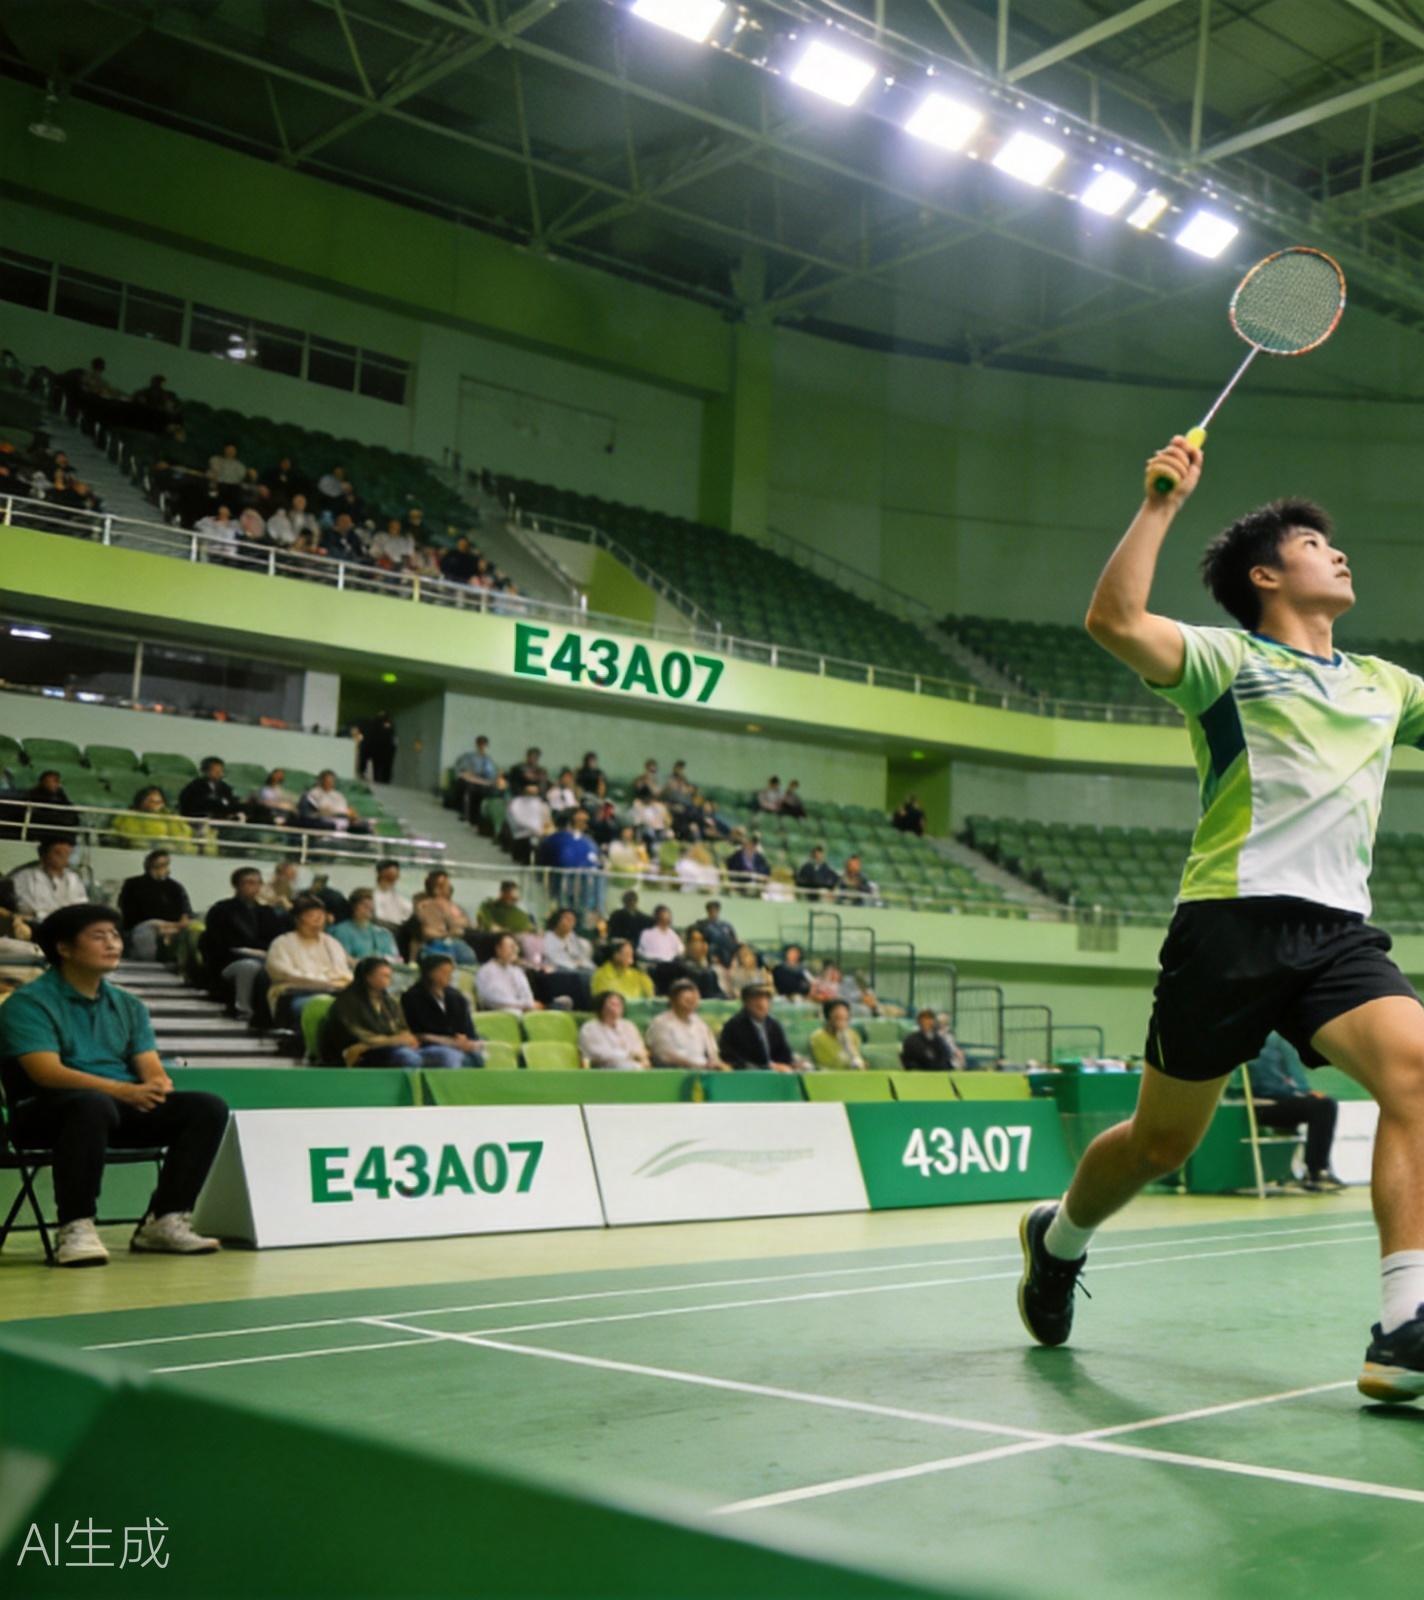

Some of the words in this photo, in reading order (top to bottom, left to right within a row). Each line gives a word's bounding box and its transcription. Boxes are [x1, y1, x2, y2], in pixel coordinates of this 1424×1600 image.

[514, 622, 725, 703] E43A07
[308, 1140, 544, 1203] E43A07
[902, 1125, 1032, 1177] 43A07
